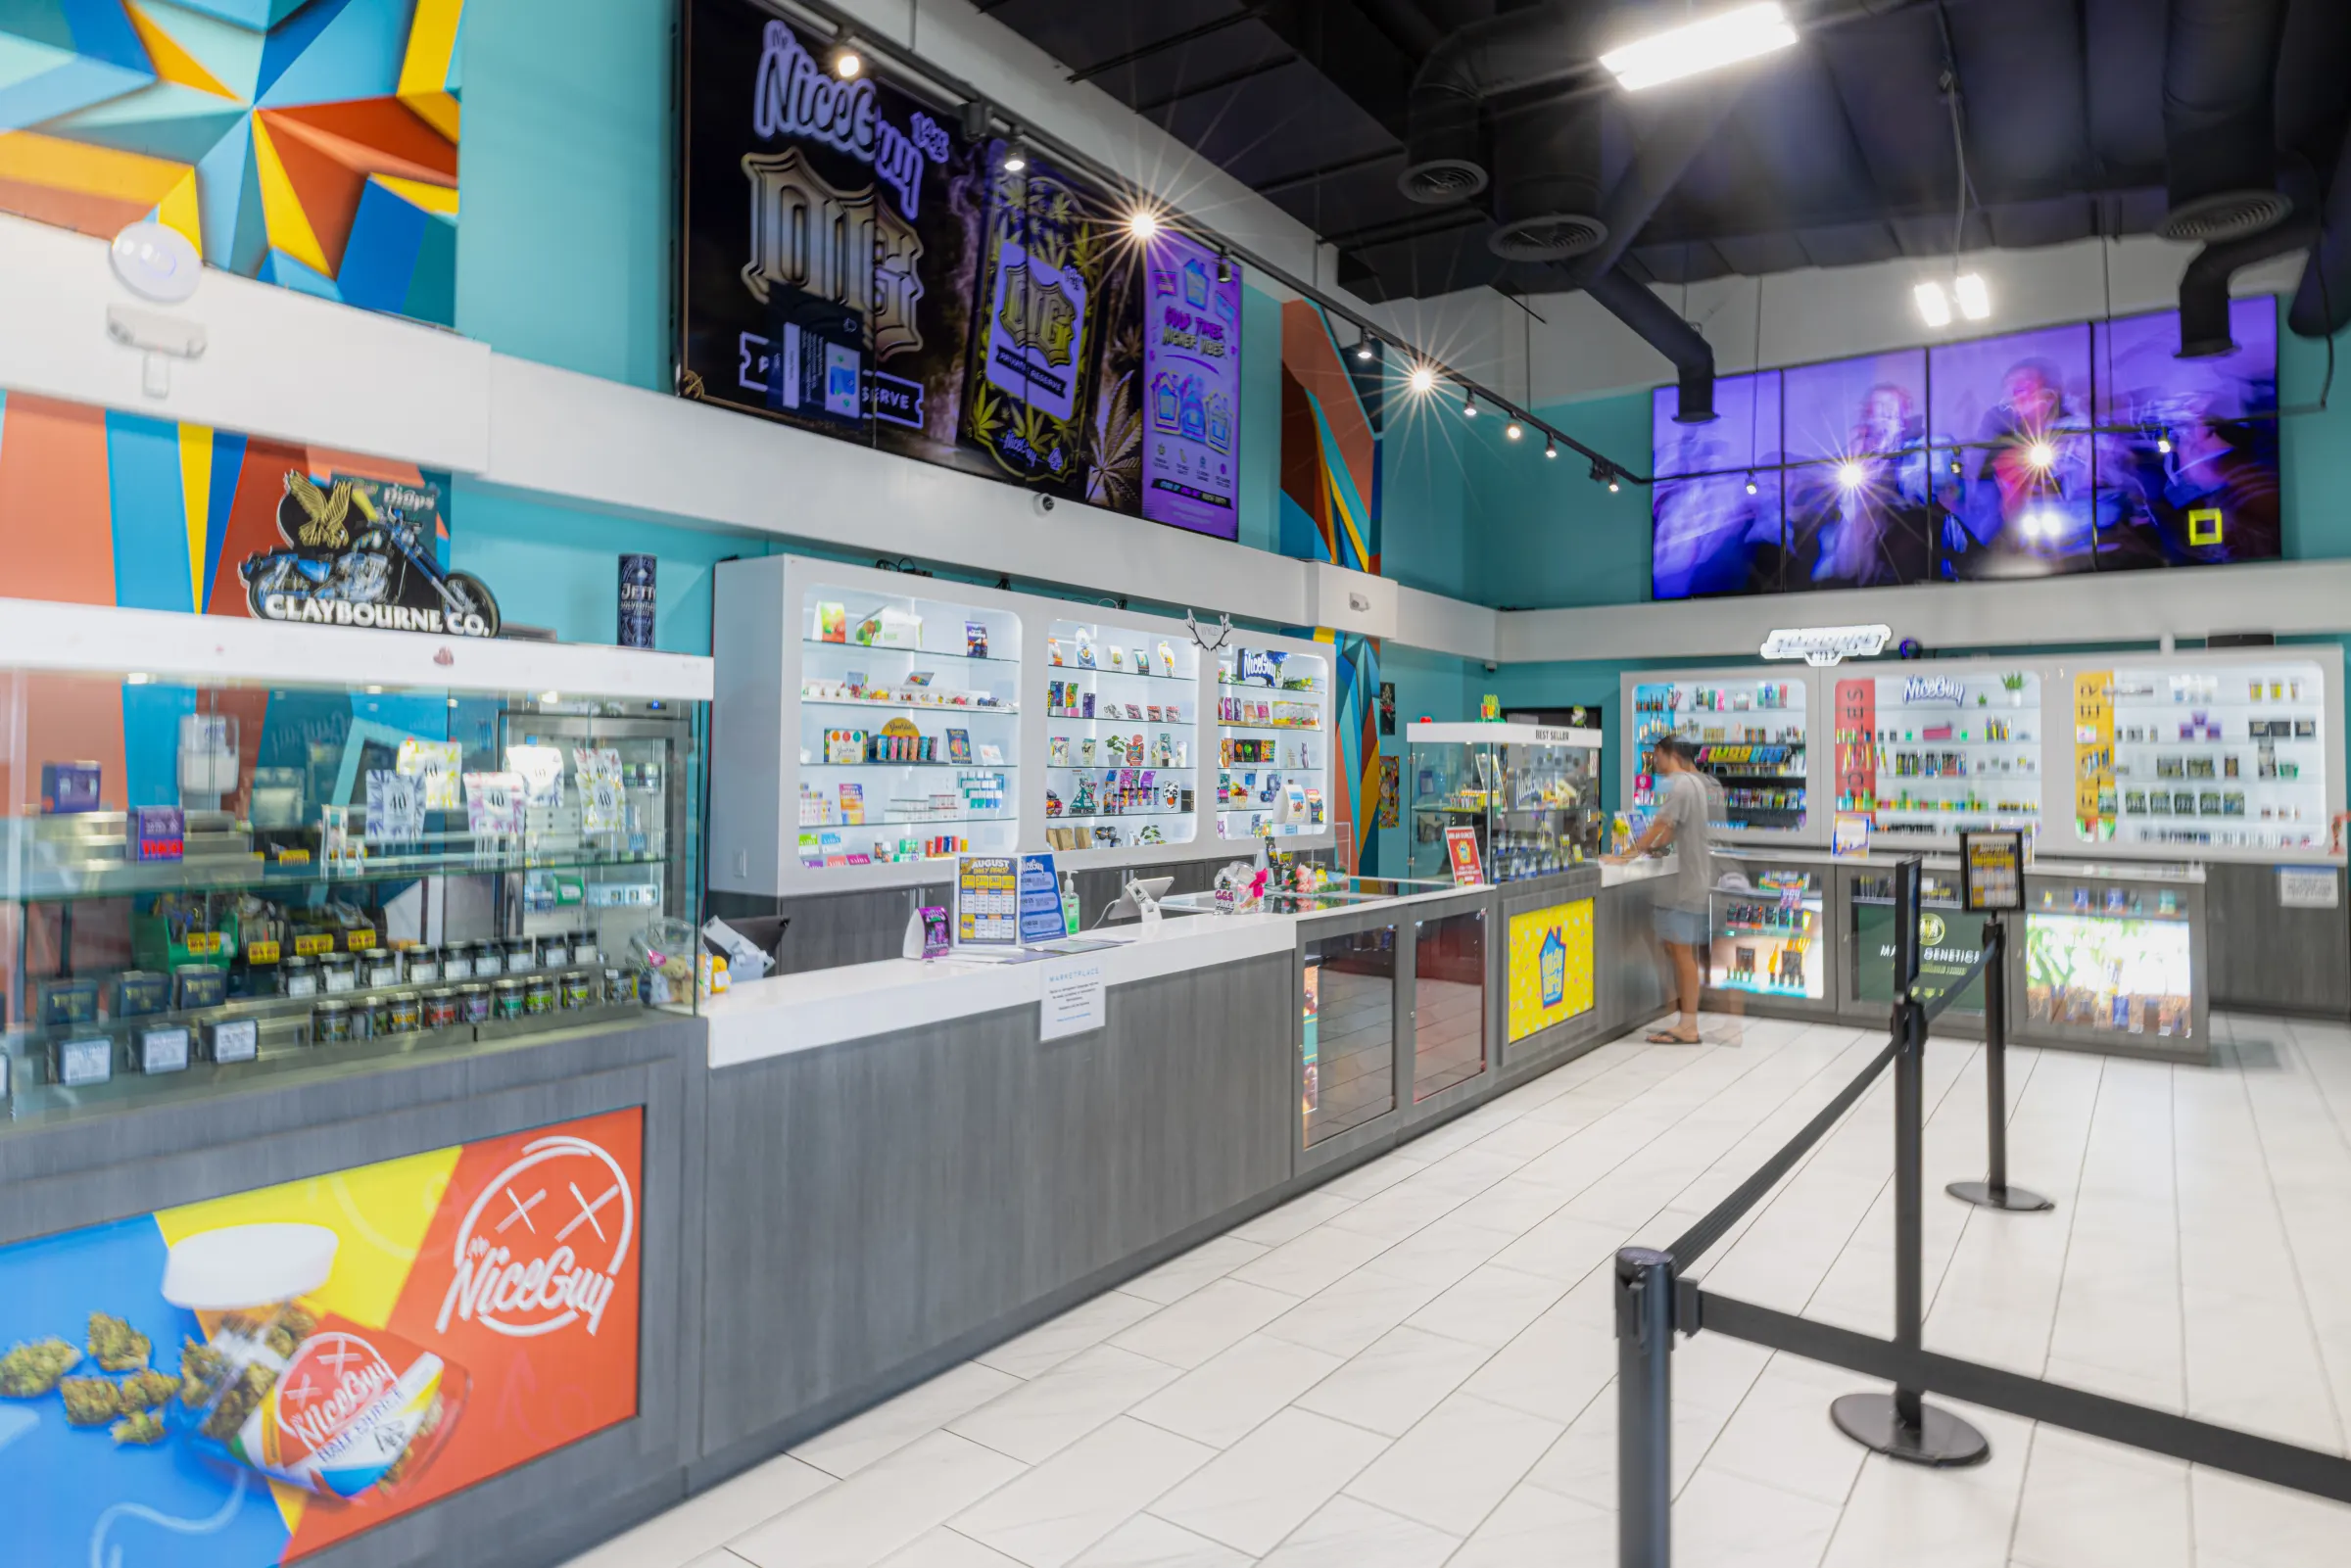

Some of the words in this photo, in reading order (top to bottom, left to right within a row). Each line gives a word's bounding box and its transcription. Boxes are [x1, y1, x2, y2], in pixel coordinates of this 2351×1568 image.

[1030, 368, 1063, 392] RESERVE
[861, 386, 910, 410] SERVE
[264, 594, 443, 632] CLAYBOURNE
[447, 612, 490, 637] CO.
[1902, 675, 1965, 707] NiceGuy
[1535, 729, 1550, 740] BEST
[1550, 731, 1569, 740] SELLER
[390, 796, 408, 811] 40
[598, 791, 611, 807] 40
[972, 859, 1010, 869] AUGUST
[1049, 967, 1099, 981] MARKETPLACE
[435, 1245, 616, 1336] NiceGuy
[293, 1360, 390, 1453] NiceGuy
[317, 1431, 353, 1462] HALF
